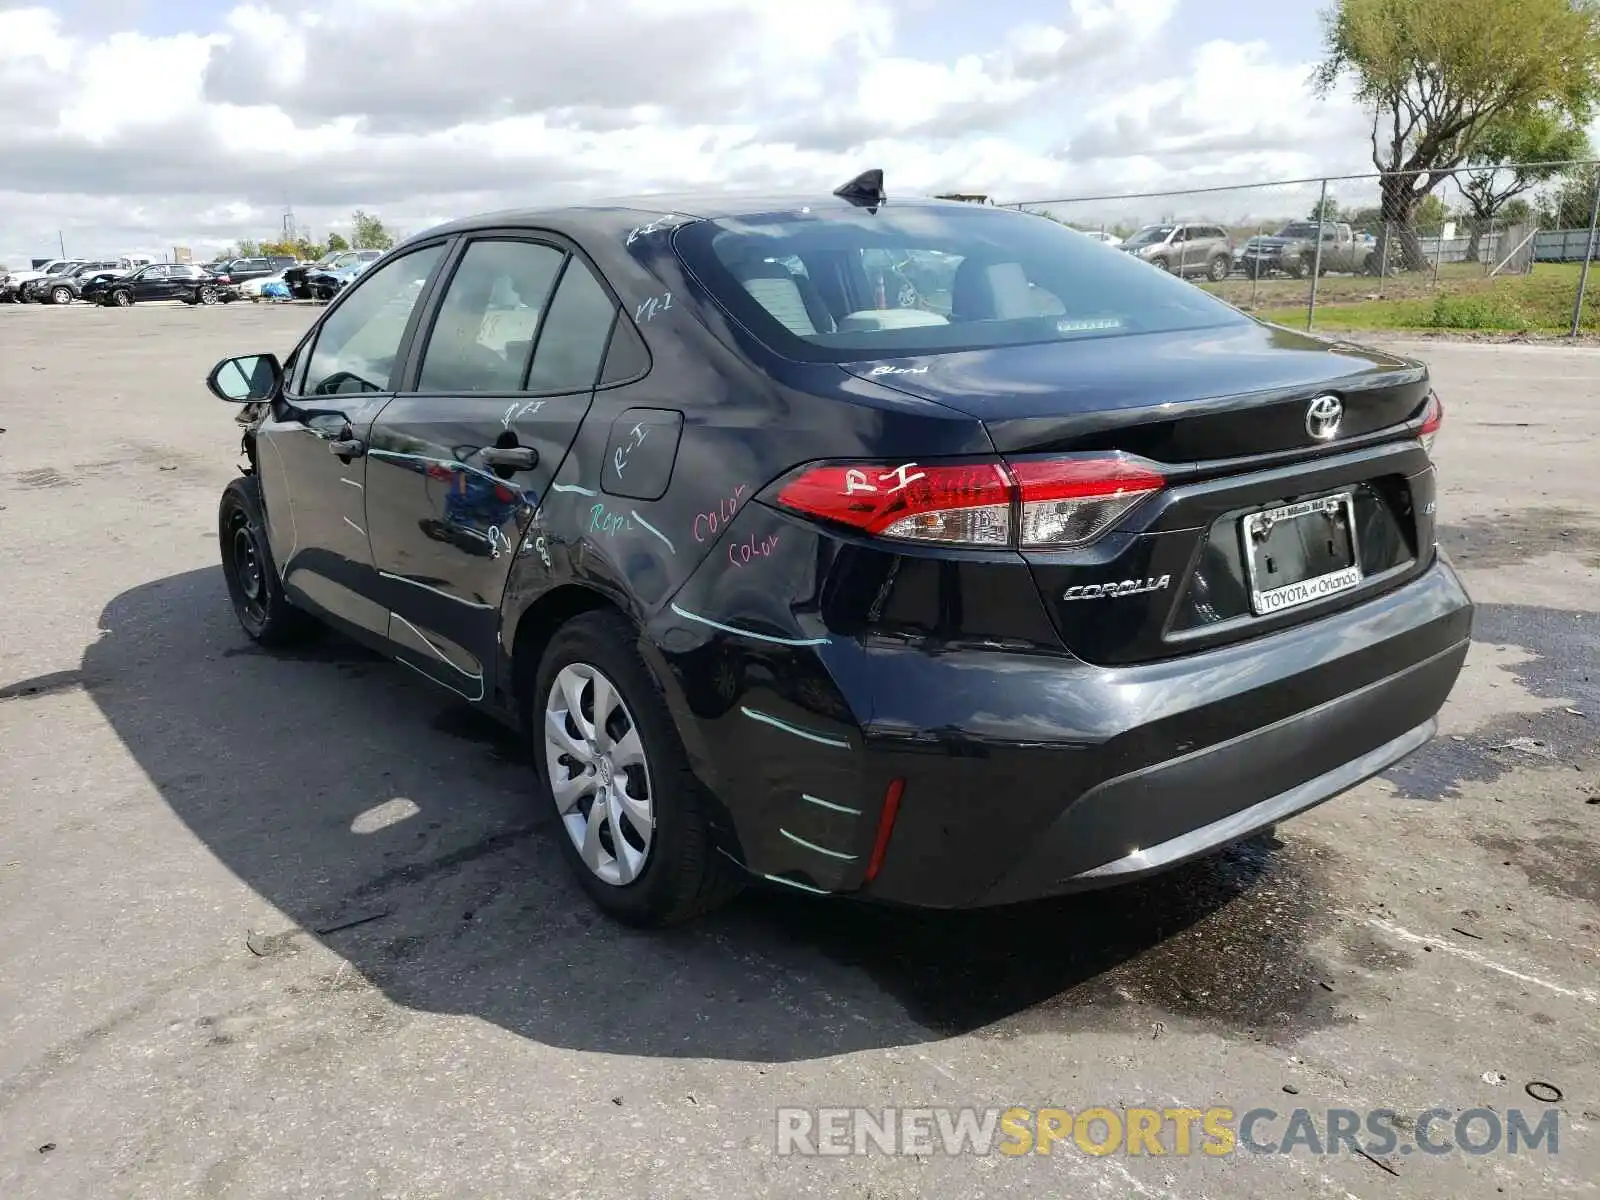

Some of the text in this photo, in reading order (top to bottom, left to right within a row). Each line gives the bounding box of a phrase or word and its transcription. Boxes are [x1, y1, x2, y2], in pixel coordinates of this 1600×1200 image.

[1063, 574, 1171, 602] COROLLA
[1263, 586, 1309, 609] TOYOTA
[1318, 572, 1357, 593] Orlando
